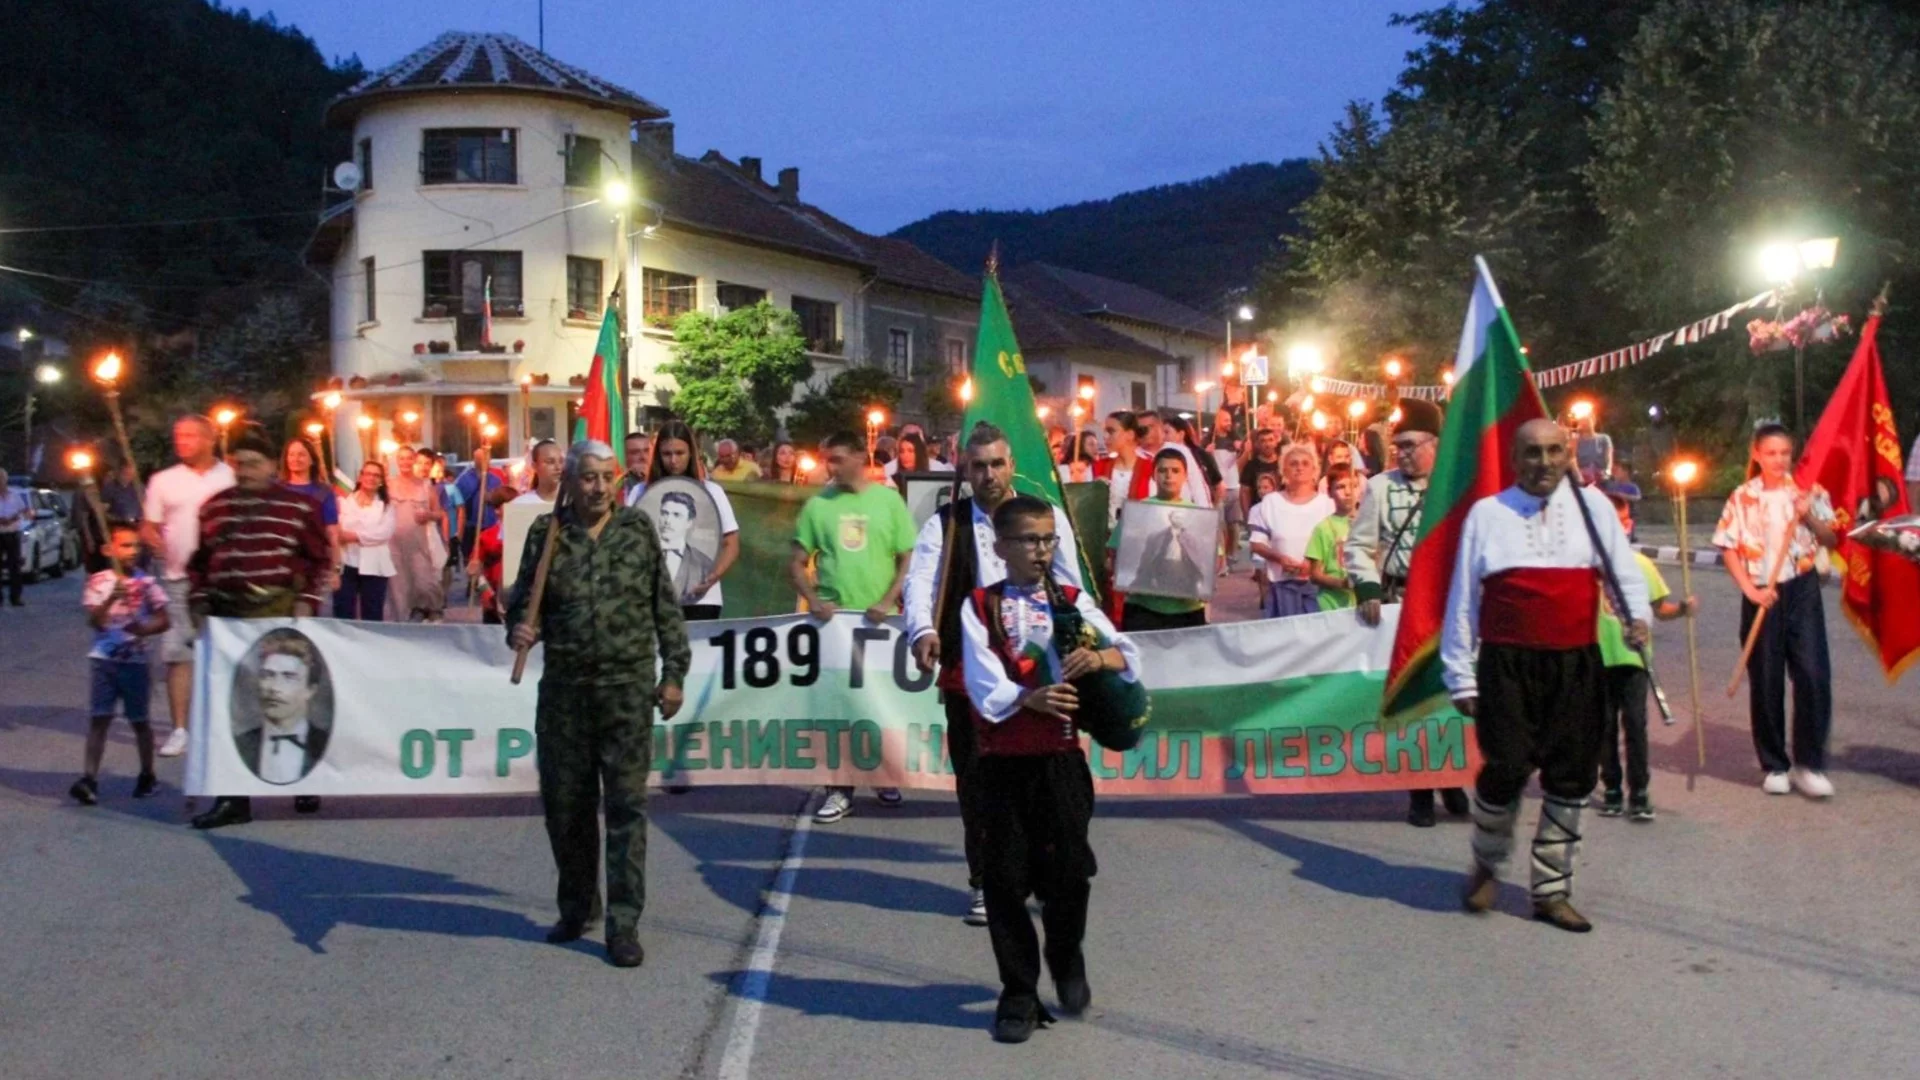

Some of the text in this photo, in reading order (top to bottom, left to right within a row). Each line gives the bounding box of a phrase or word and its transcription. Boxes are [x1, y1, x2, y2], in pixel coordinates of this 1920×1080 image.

[709, 623, 820, 689] 189
[400, 728, 474, 779] ОТ
[906, 722, 955, 775] Н
[1224, 716, 1466, 779] ЛЕВСКИ
